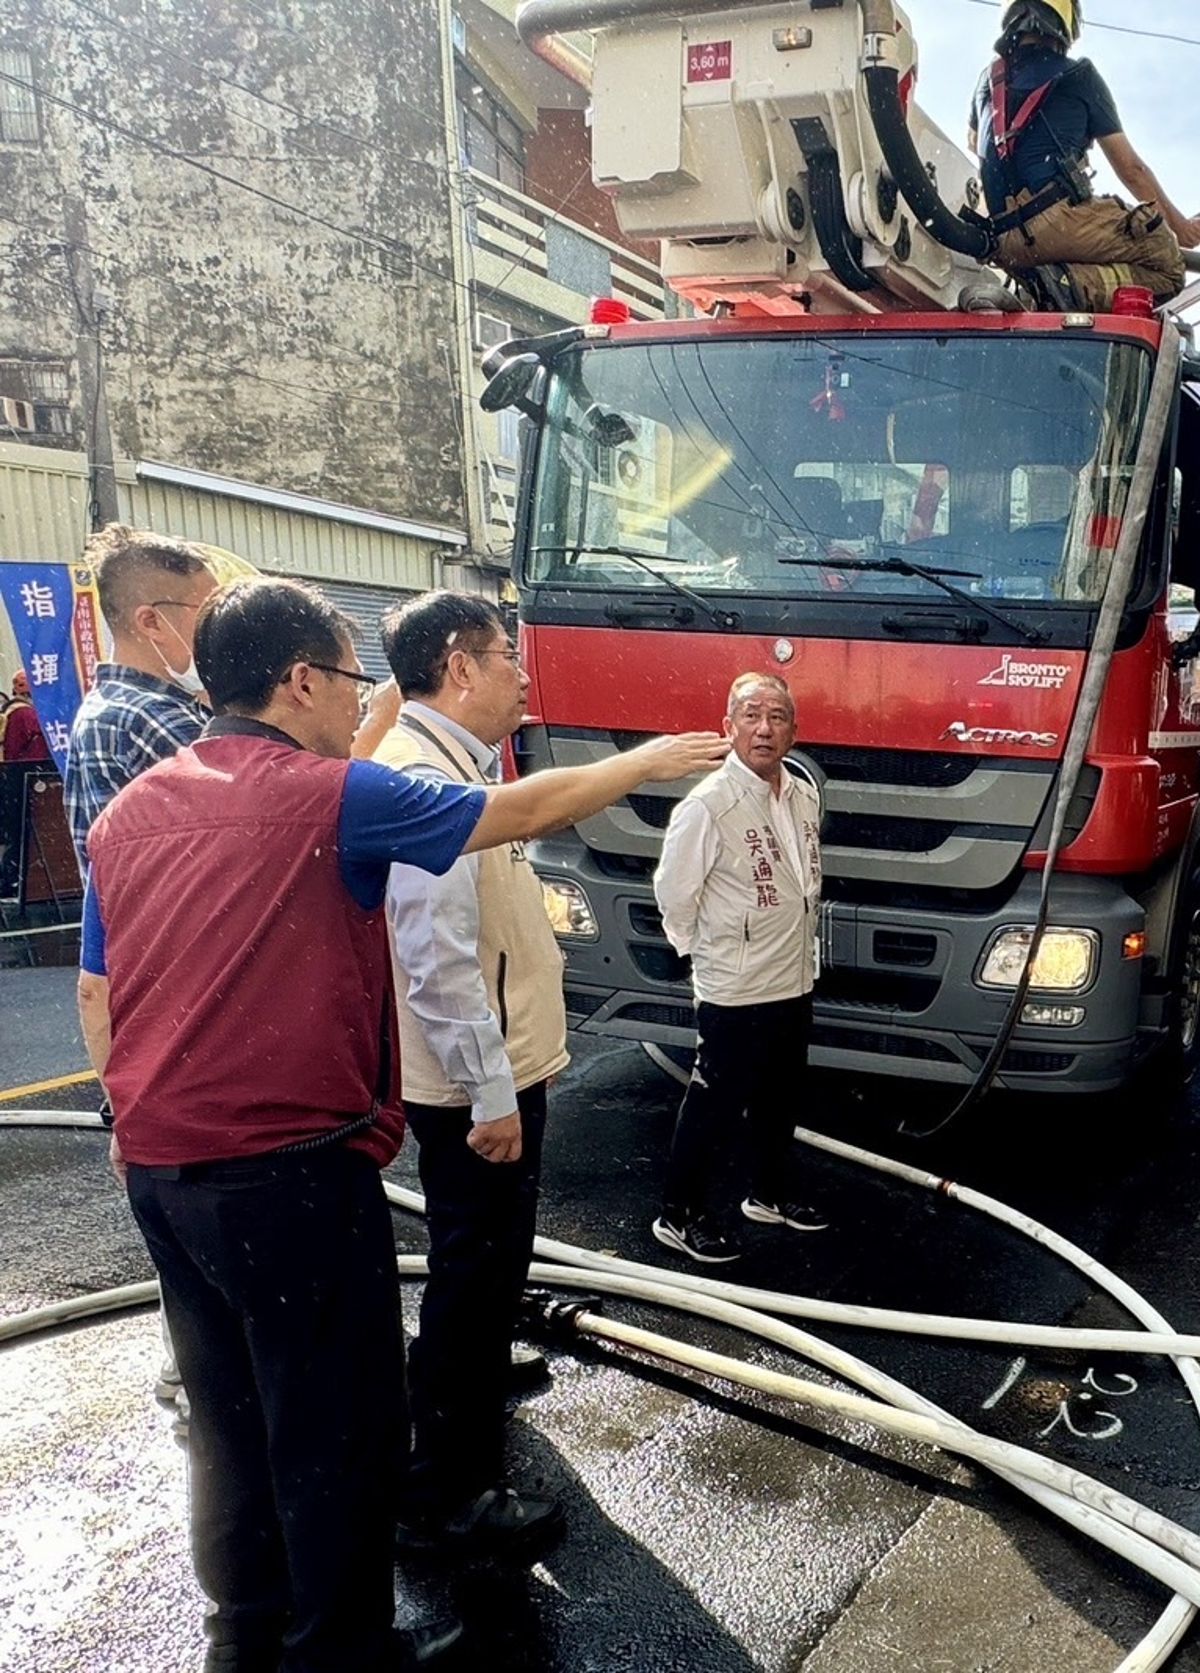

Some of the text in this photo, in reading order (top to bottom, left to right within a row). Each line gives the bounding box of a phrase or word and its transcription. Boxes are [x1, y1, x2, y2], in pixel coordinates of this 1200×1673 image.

[690, 55, 729, 72] 3,60 m
[20, 580, 70, 753] 指揮站
[1008, 662, 1067, 676] BRONTO
[1008, 675, 1064, 688] SKYLIFT
[743, 828, 780, 908] 吳通龍
